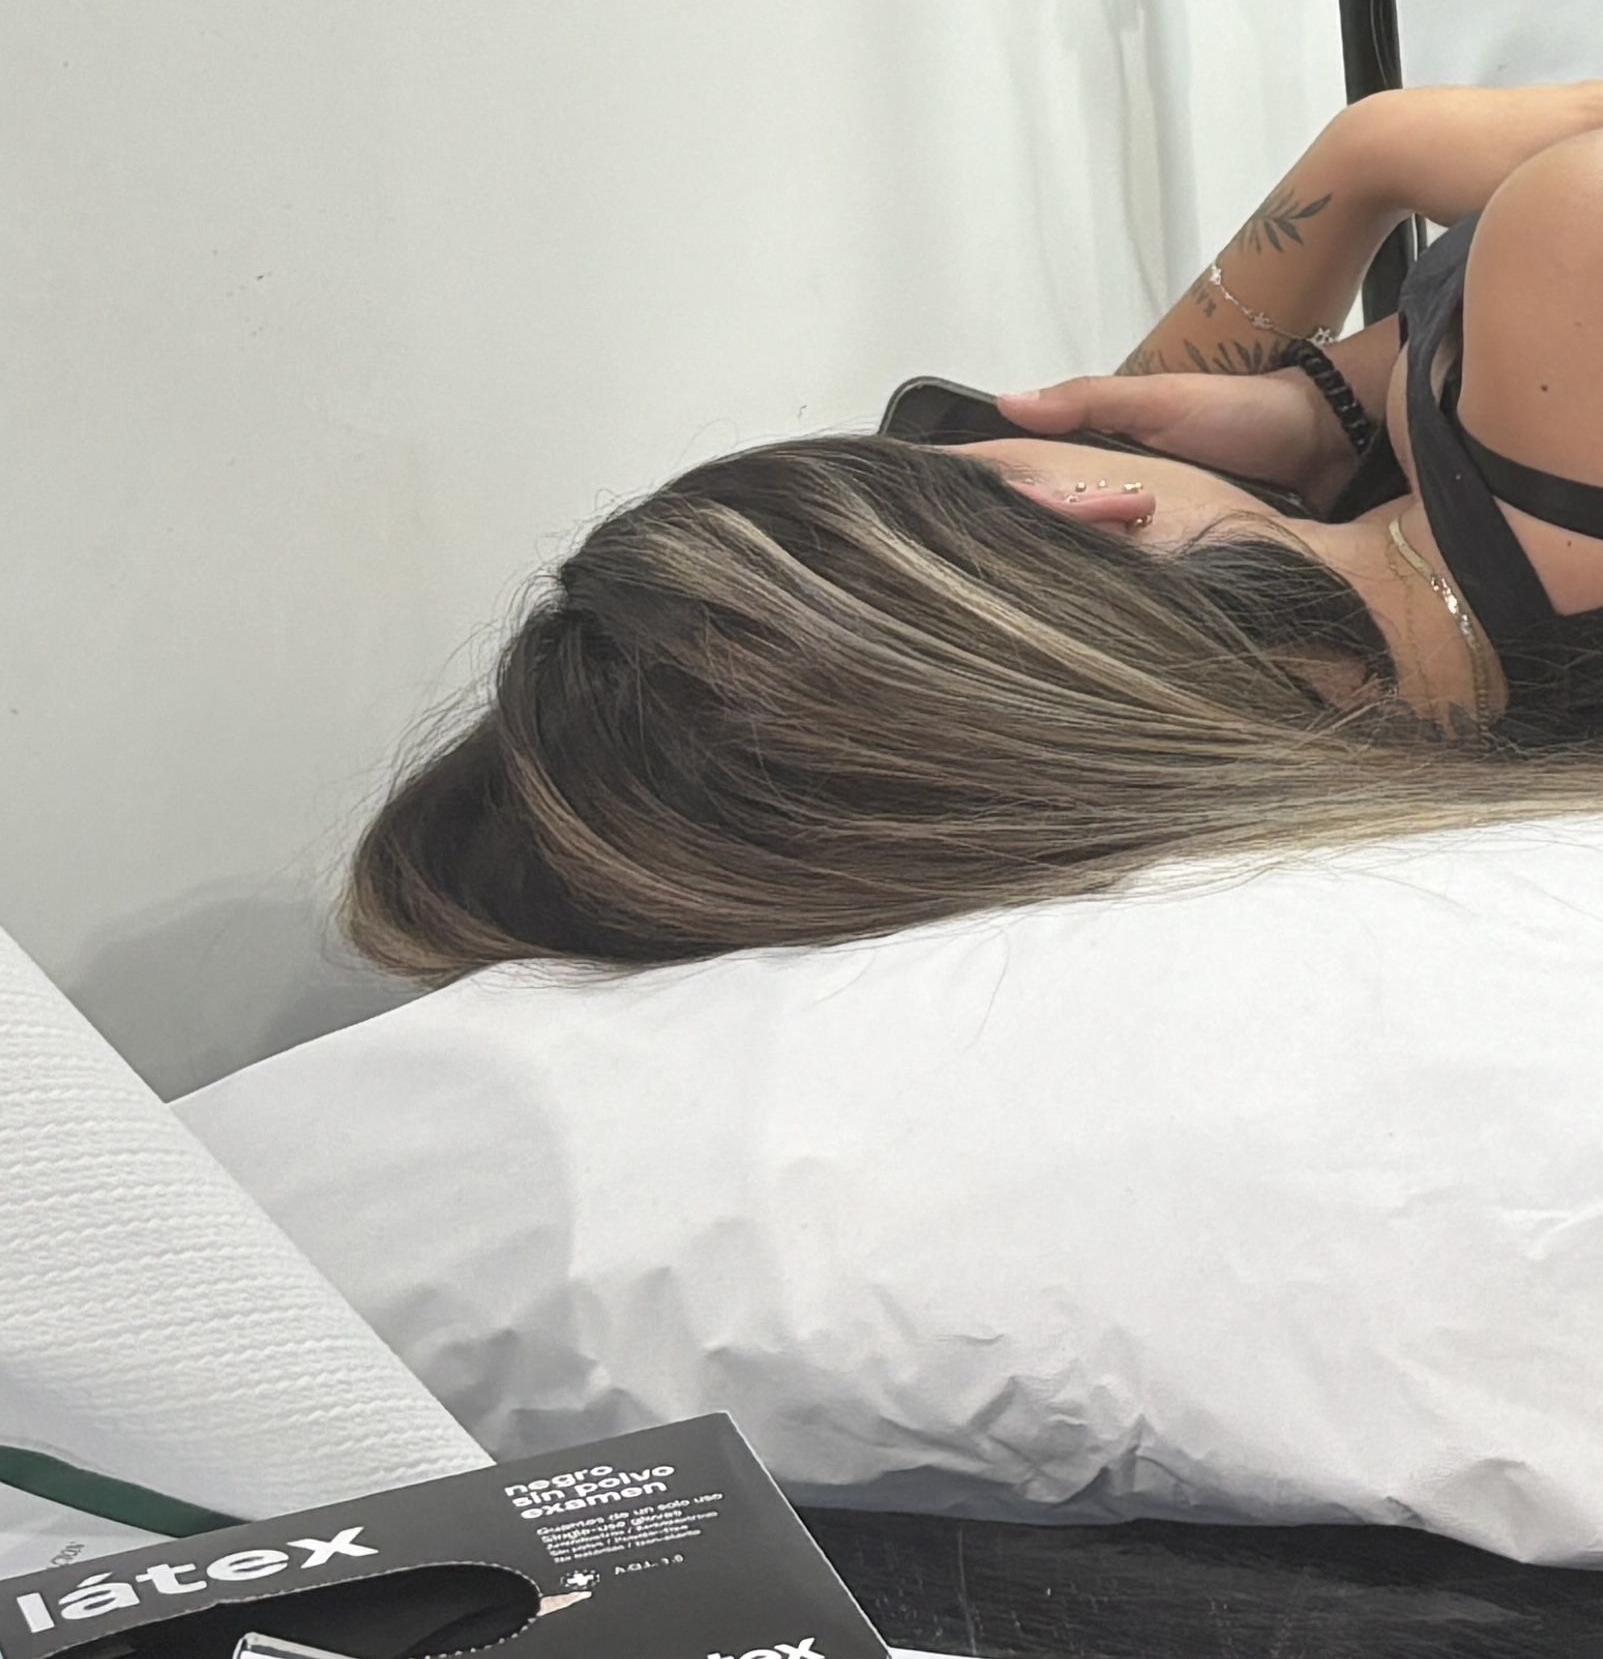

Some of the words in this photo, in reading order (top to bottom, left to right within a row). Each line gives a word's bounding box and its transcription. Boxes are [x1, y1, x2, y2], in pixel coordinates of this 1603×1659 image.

[504, 1465, 613, 1497] negro
[512, 1488, 565, 1508] sin
[575, 1465, 675, 1498] polvo
[520, 1481, 667, 1520] examen
[16, 1526, 379, 1634] látex
